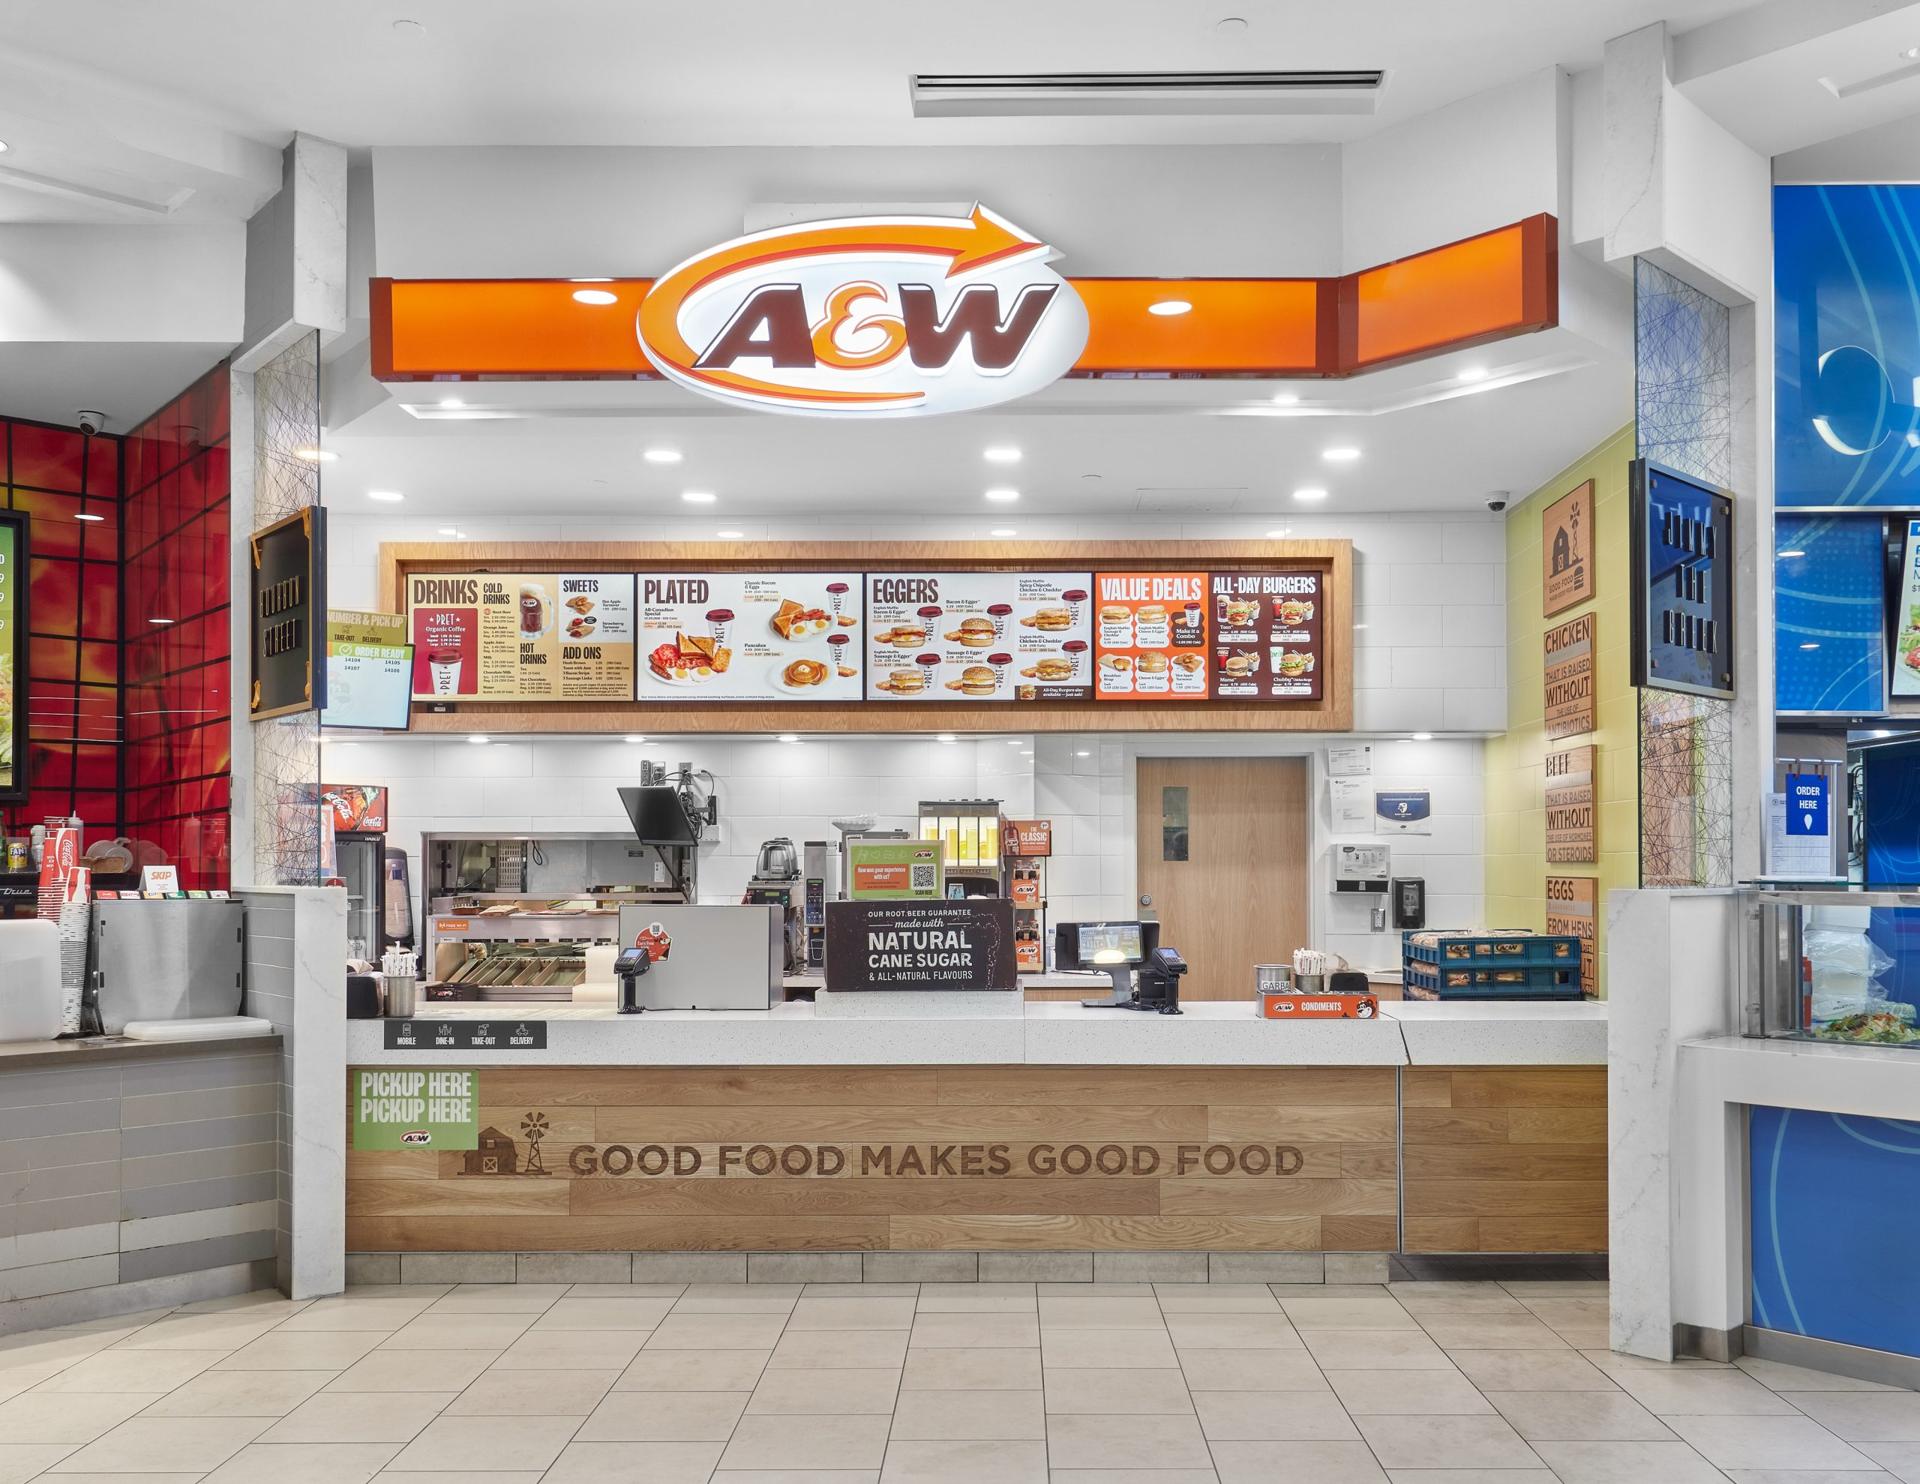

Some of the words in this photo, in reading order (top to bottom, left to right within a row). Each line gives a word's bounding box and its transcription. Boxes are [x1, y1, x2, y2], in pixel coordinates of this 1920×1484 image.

[691, 279, 1060, 377] A&W
[483, 583, 502, 593] COLD
[563, 579, 599, 592] SWEETS
[1101, 578, 1149, 600] VALUE
[1152, 578, 1201, 600] DEALS
[1212, 577, 1262, 594] ALL-DAY
[1262, 577, 1316, 594] BURGERS
[1679, 563, 1707, 604] THE
[413, 579, 478, 604] DRINKS
[644, 579, 709, 604] PLATED
[873, 579, 939, 603] EGGERS
[483, 594, 510, 604] DRINKS
[362, 615, 369, 625] &
[370, 616, 390, 627] PICK
[390, 618, 403, 628] UP
[436, 613, 454, 625] PRET
[1545, 617, 1590, 655] CHICKEN
[1667, 609, 1718, 655] GREEK
[355, 646, 380, 657] ORDER
[381, 648, 405, 658] READY
[520, 643, 535, 653] HOT
[562, 646, 581, 659] ADD
[583, 646, 602, 659] ONS
[520, 654, 547, 664] DRINKS
[1545, 669, 1560, 682] THAT
[1561, 667, 1568, 679] IS
[1568, 658, 1591, 676] RAISED
[1545, 676, 1590, 707] WITHOUT
[1546, 714, 1590, 736] ANTIBIOTICS
[1545, 753, 1570, 777] BEEF
[1547, 793, 1560, 804] THAT
[1569, 790, 1592, 803] RAISED
[1796, 786, 1820, 796] ORDER
[1799, 800, 1818, 809] HERE
[1547, 807, 1591, 830] WITHOUT
[1020, 832, 1047, 842] CLASSIC
[1547, 848, 1558, 860] OR
[1559, 846, 1592, 860] STEROIDS
[151, 871, 172, 880] SKIP
[1547, 879, 1574, 901] EGGS
[894, 919, 922, 928] made
[922, 917, 944, 928] with
[1547, 918, 1569, 935] FROM
[1571, 920, 1593, 939] HENS
[868, 930, 972, 951] NATURAL
[868, 953, 913, 968] CANE
[916, 952, 972, 967] SUGAR
[869, 972, 875, 981] &
[877, 971, 931, 981] ALL-NATURAL
[933, 970, 973, 980] FLAVOURS
[1301, 1002, 1342, 1011] CONDIMENTS
[397, 1037, 416, 1045] MOBILE
[436, 1037, 455, 1045] DINE-IN
[471, 1037, 496, 1045] TAKE-OUT
[510, 1037, 534, 1045] DELIVERY
[361, 1072, 426, 1097] PICKUP
[428, 1072, 472, 1097] HERE
[361, 1098, 426, 1123] PICKUP
[428, 1098, 472, 1123] HERE
[404, 1134, 429, 1142] A&W
[569, 1144, 703, 1177] GOOD
[718, 1144, 846, 1177] FOOD
[861, 1144, 1011, 1177] MAKES
[1028, 1144, 1161, 1177] GOOD
[1177, 1144, 1304, 1177] FOOD
